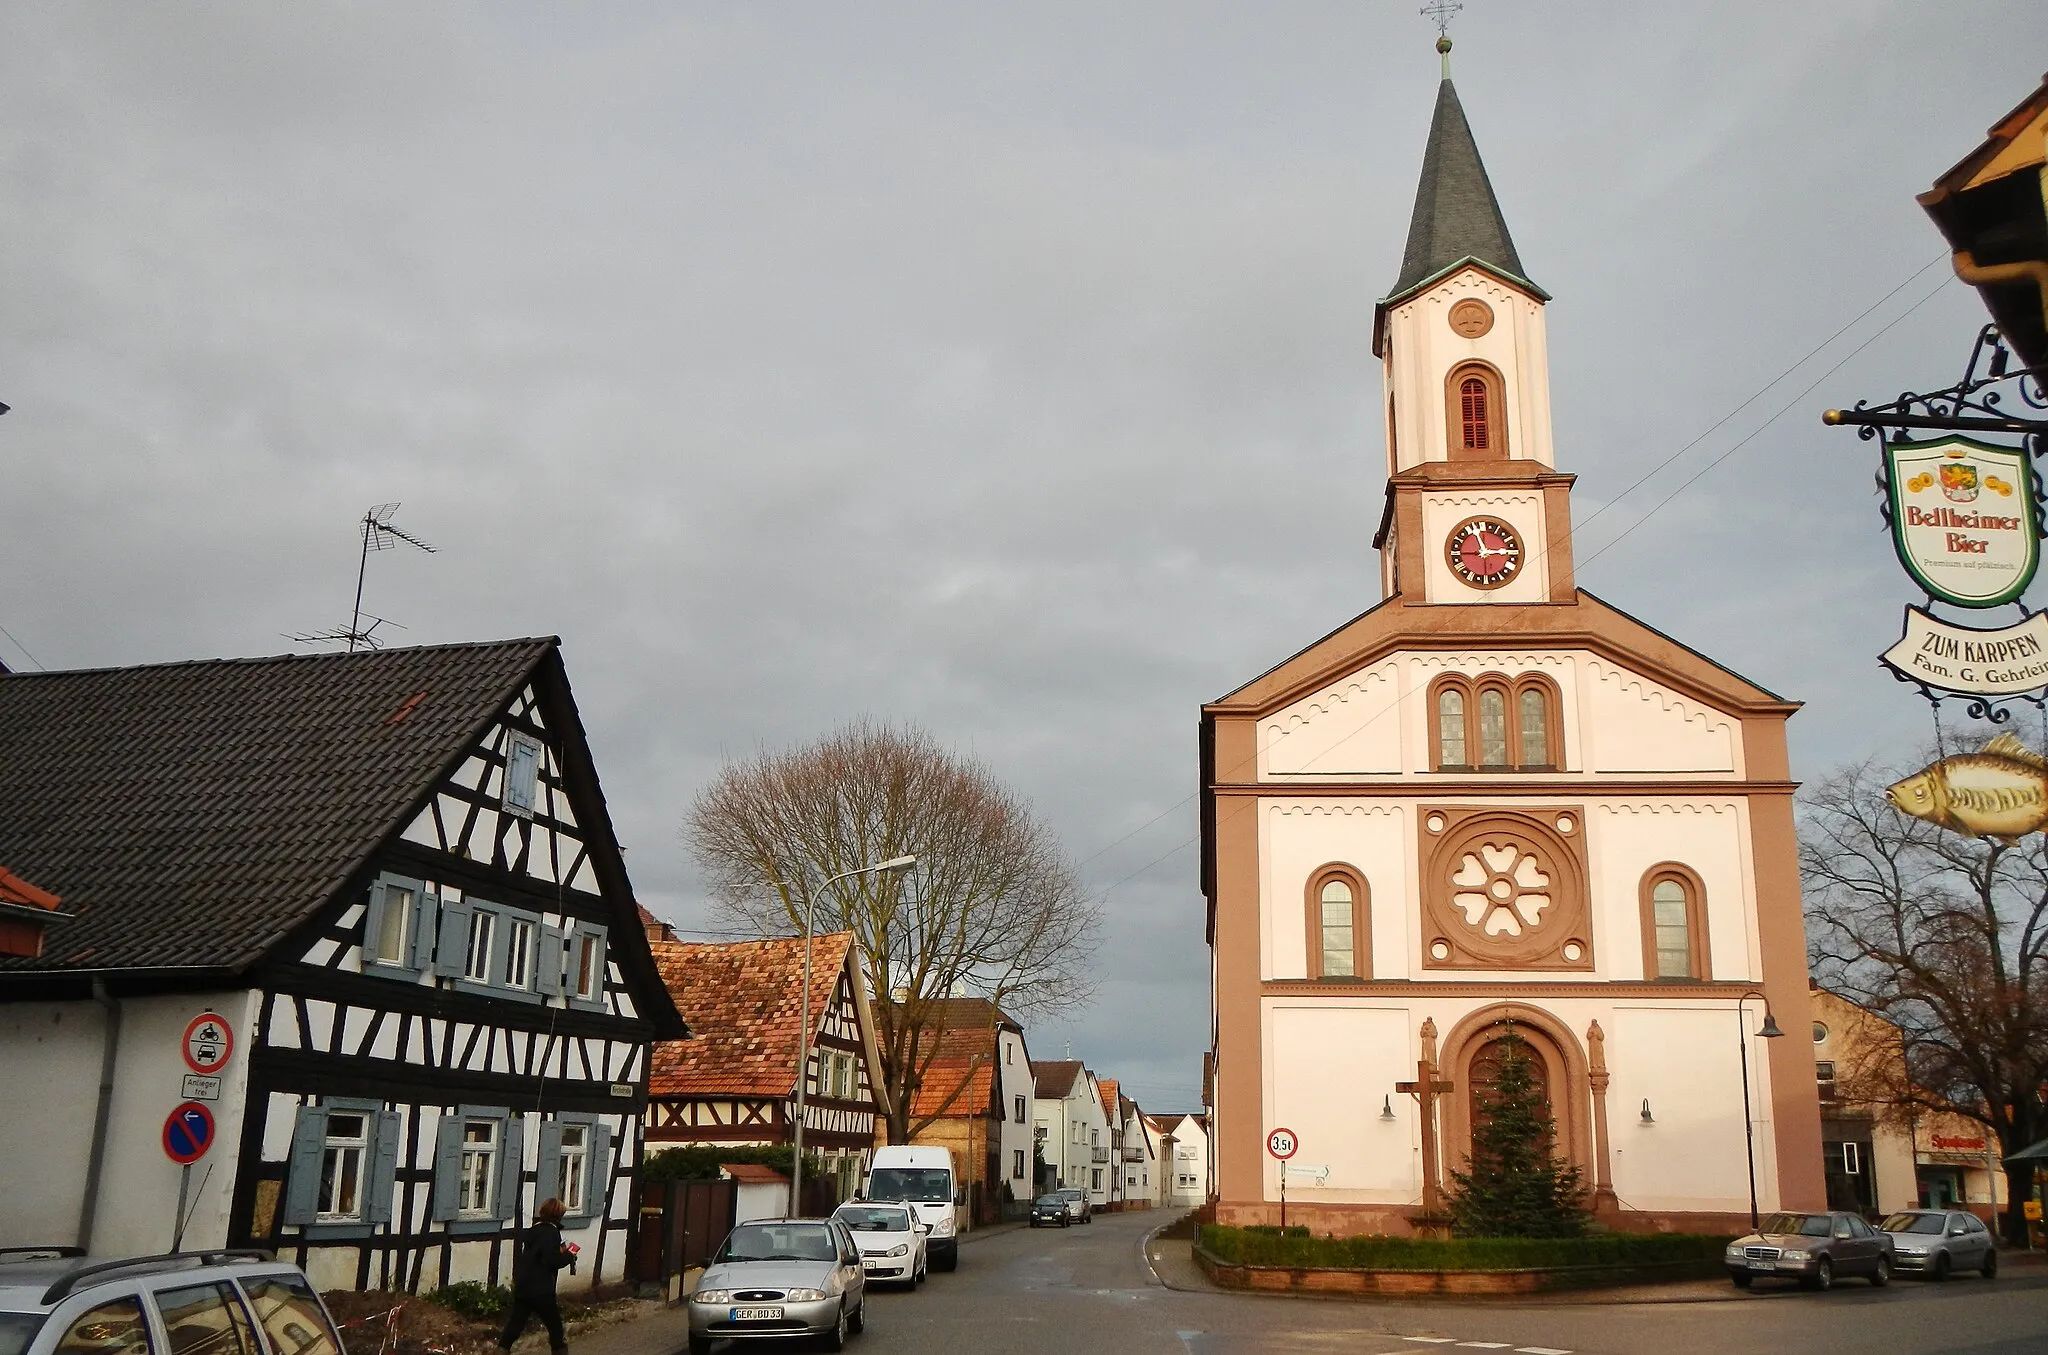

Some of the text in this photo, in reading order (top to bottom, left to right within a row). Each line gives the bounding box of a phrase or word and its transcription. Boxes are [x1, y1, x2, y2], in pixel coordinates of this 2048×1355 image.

[1906, 506, 2021, 530] Bellheimer
[1945, 532, 1989, 553] Bier
[1923, 559, 1961, 569] Premium
[1921, 632, 2042, 663] ZUM KARPFEN
[1912, 652, 1953, 678] Fam.
[1960, 668, 1980, 682] G.
[187, 1078, 217, 1089] Anlieger
[736, 1310, 781, 1319] GER BD 33
